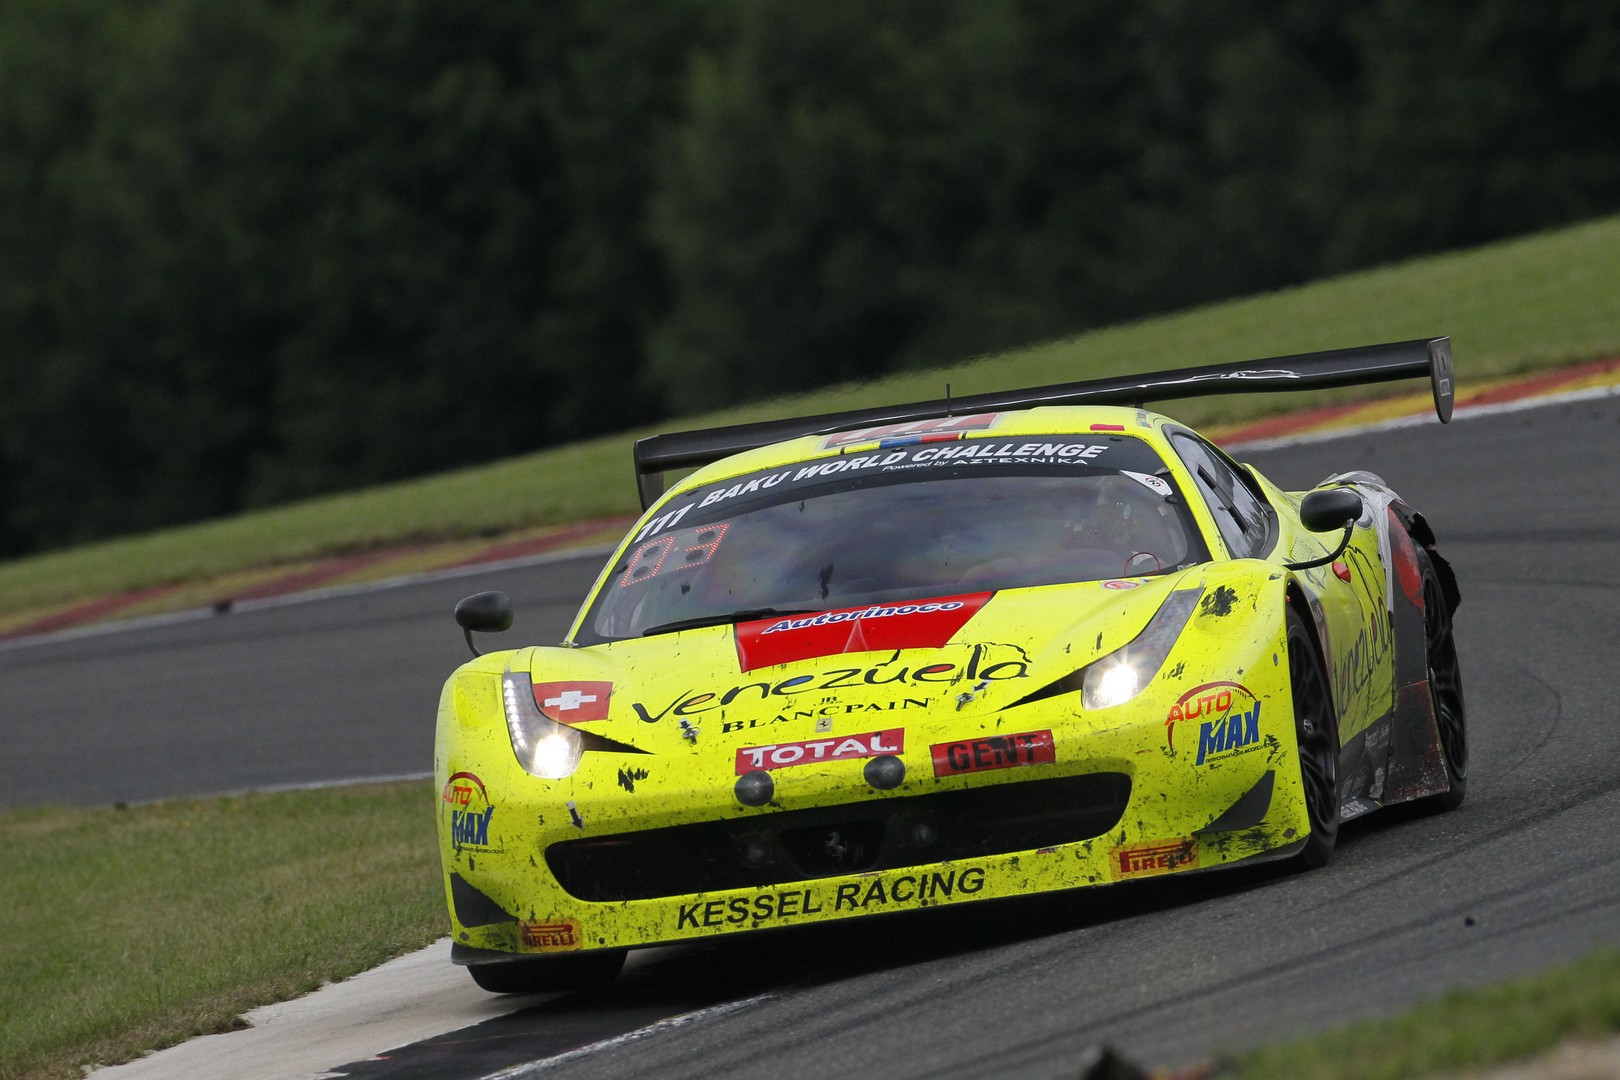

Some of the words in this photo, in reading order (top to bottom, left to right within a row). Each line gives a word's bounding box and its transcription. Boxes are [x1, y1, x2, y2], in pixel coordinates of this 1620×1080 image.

[698, 471, 792, 508] BAKU
[792, 451, 907, 482] WORLD
[912, 443, 1109, 462] CHALLENGE
[882, 461, 932, 471] Powered
[934, 460, 949, 468] by
[634, 503, 695, 544] 111
[761, 601, 964, 634] Autorinoco
[722, 698, 930, 733] BLANCPAIN
[1164, 691, 1231, 726] AUTO
[1196, 700, 1261, 766] MAX
[742, 734, 898, 768] TOTAL
[947, 734, 1038, 771] GENT
[442, 784, 473, 805] AUTO
[452, 805, 494, 849] MAX
[1119, 840, 1195, 873] PIRELI
[677, 889, 822, 930] KESSEL
[835, 867, 985, 911] RACING
